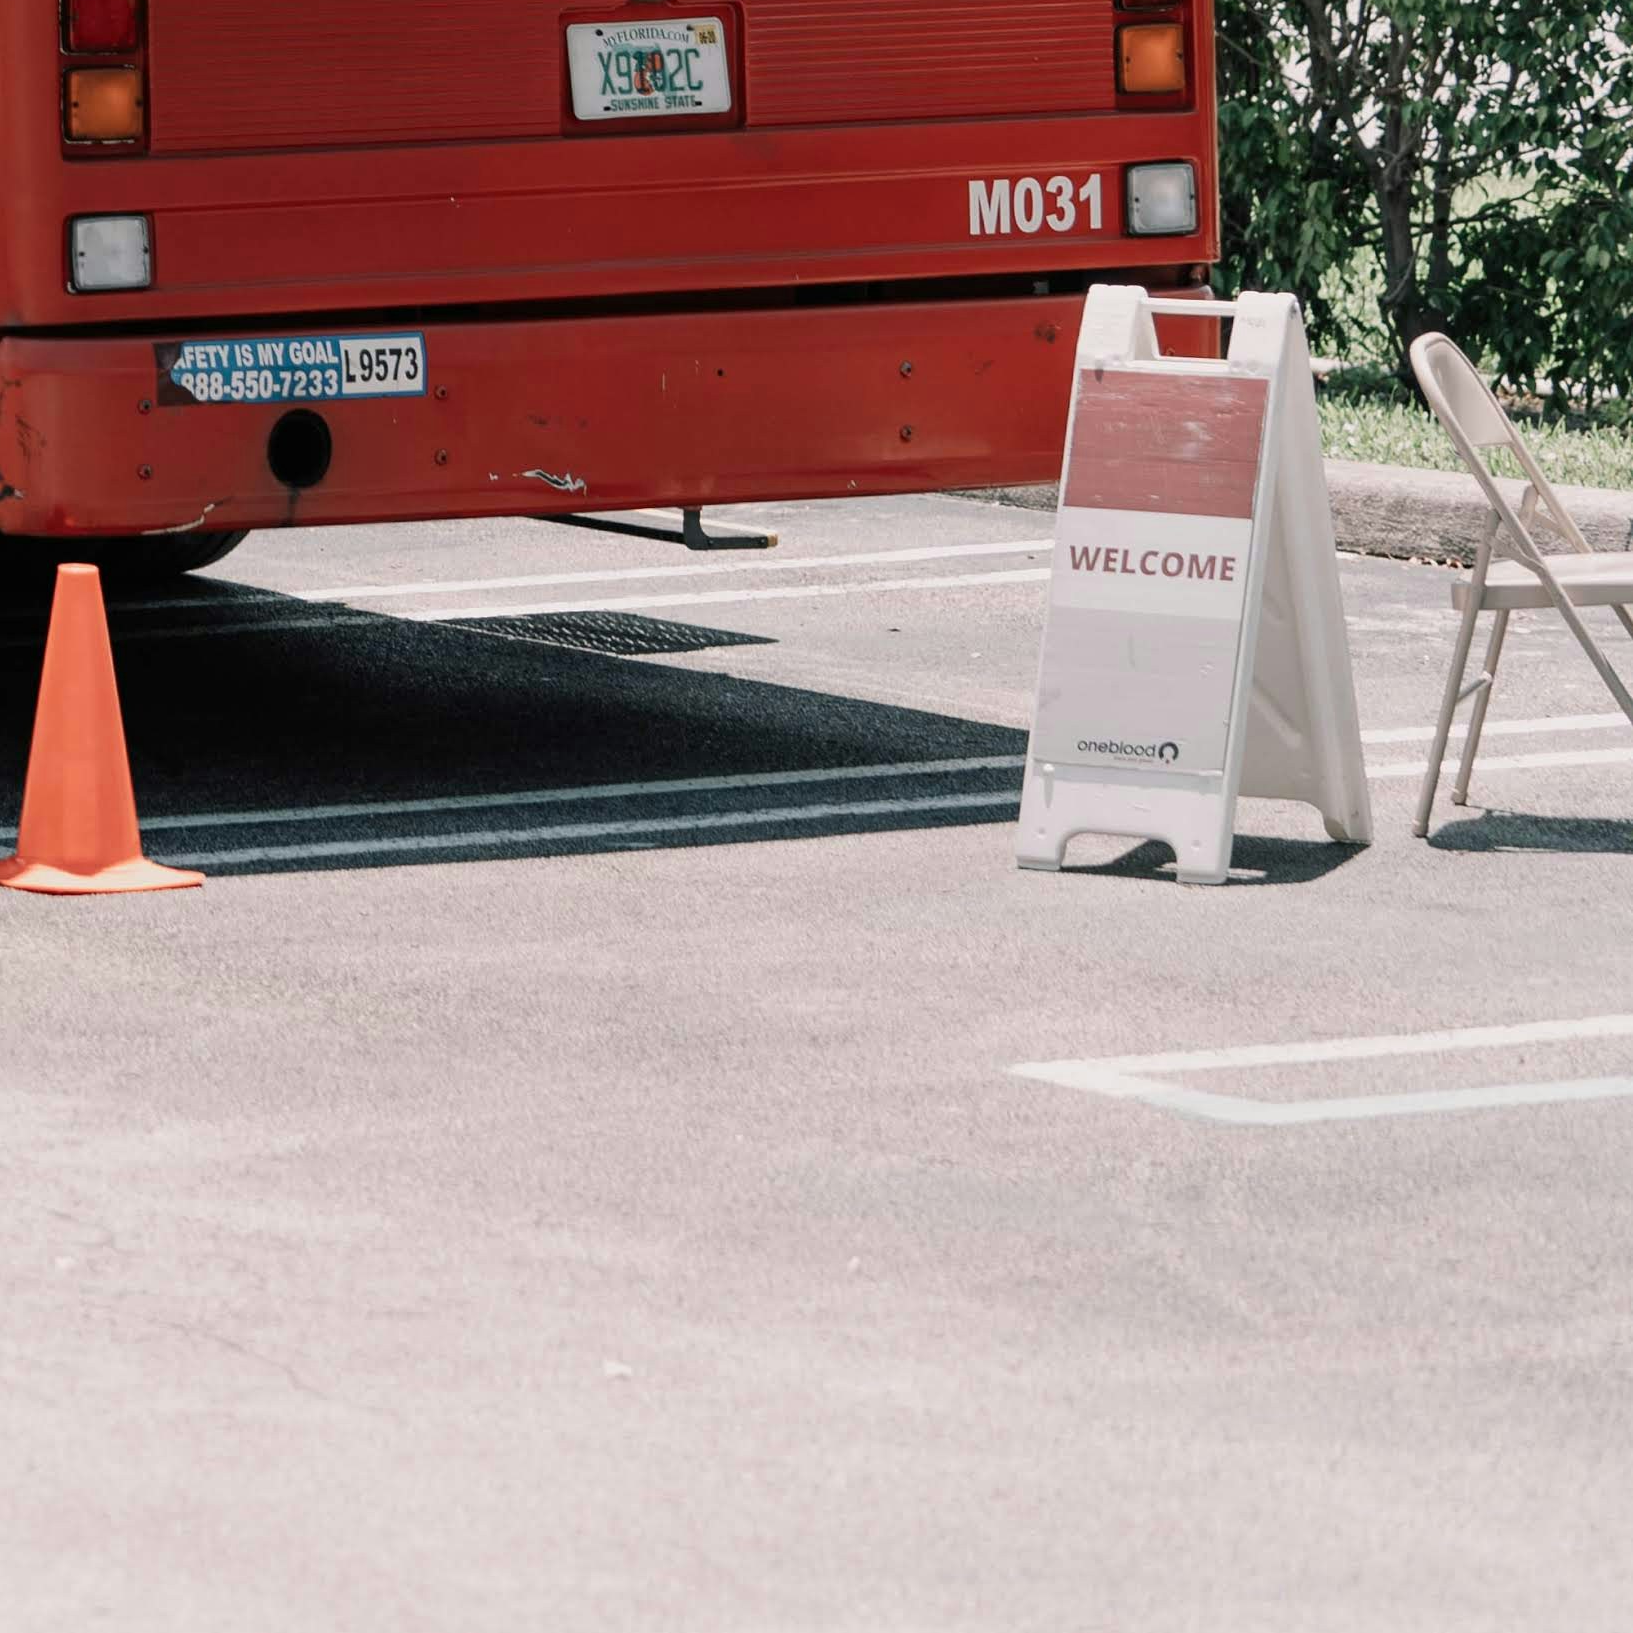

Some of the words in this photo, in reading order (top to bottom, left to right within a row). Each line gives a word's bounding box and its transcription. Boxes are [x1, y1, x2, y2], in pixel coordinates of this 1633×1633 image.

[609, 96, 660, 112] SUNSHINE
[665, 94, 697, 109] STATE
[968, 173, 1103, 236] M031
[235, 343, 254, 368] IS
[256, 341, 286, 367] MY
[289, 339, 339, 366] GOAL
[1069, 545, 1236, 581] WELCOME
[1077, 739, 1157, 757] oneblood
